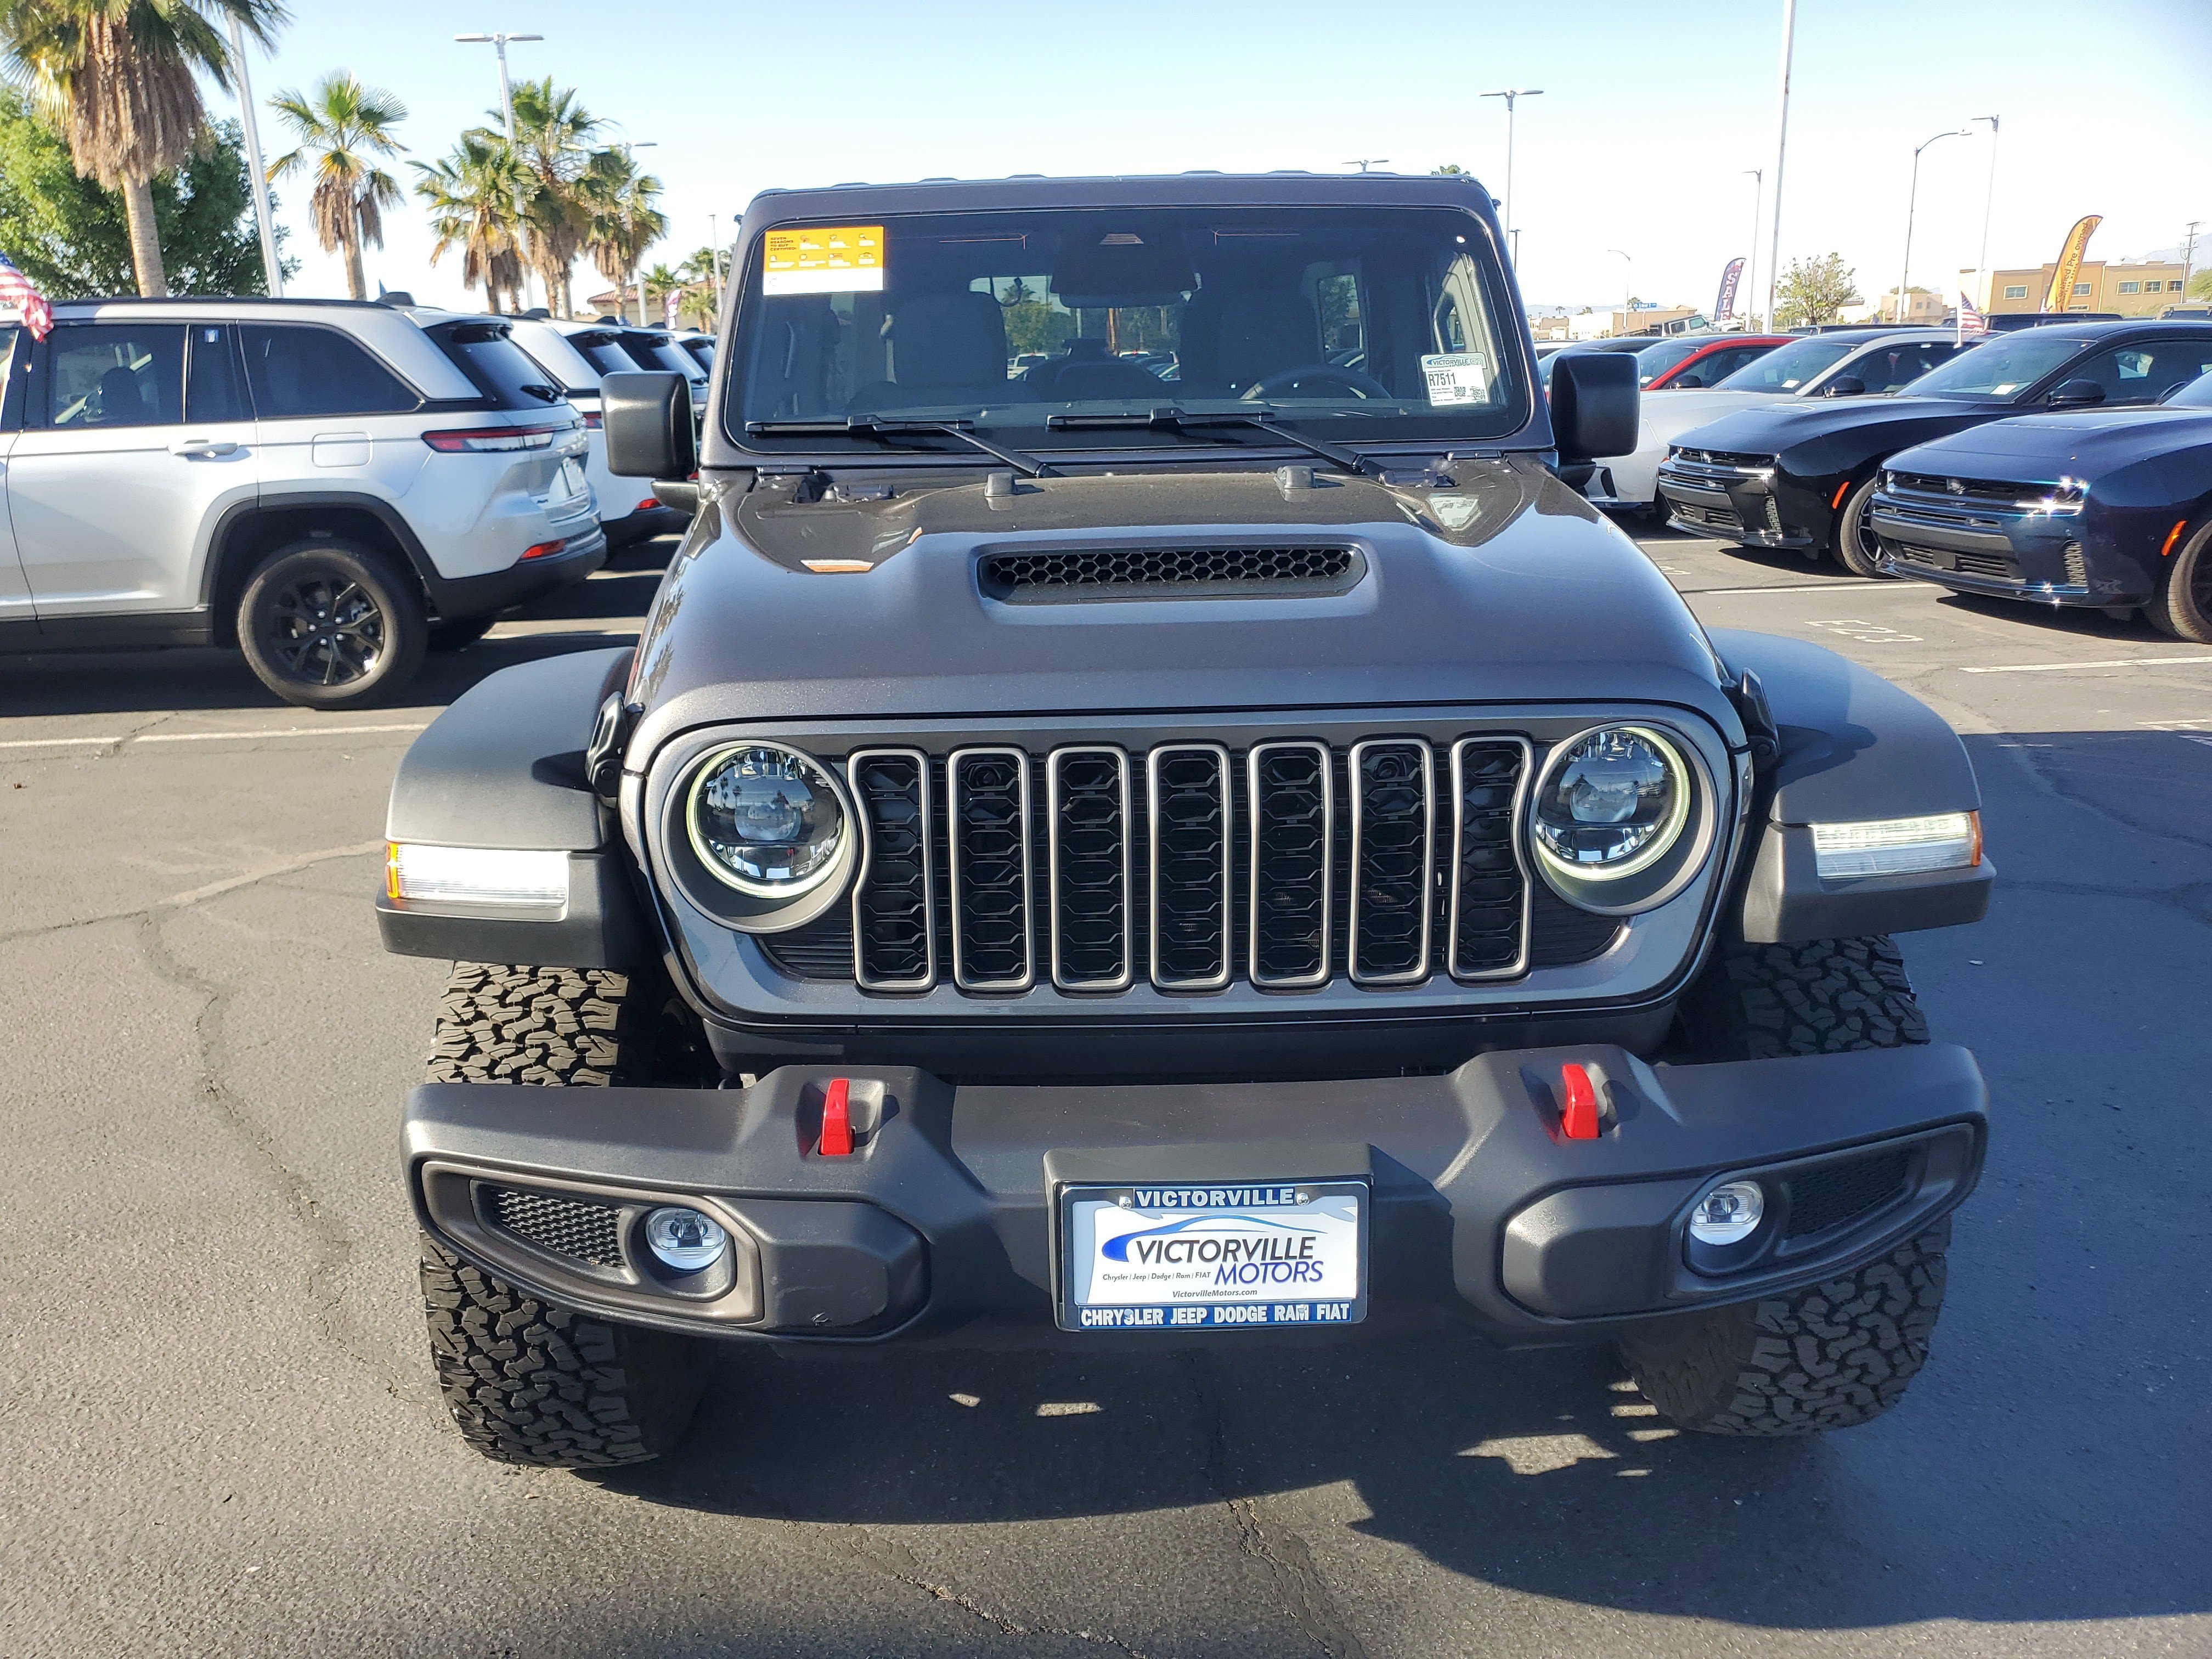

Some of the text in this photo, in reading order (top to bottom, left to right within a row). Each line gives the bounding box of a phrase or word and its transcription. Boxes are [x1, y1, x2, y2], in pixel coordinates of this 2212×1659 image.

[2067, 253, 2078, 267] Pre
[1720, 272, 1738, 320] SALE
[1428, 373, 1455, 386] R7511
[1136, 1188, 1294, 1206] VICTORVILLE
[1136, 1236, 1317, 1265] VICTORVILLE
[1103, 1273, 1128, 1282] Chrysler
[1152, 1272, 1171, 1281] Dodge
[1214, 1260, 1324, 1285] MOTORS
[1172, 1289, 1257, 1298] VictorvilleMotors.com
[1081, 1303, 1350, 1326] CHRYSLER JEEP DODGE RAM FIAT
